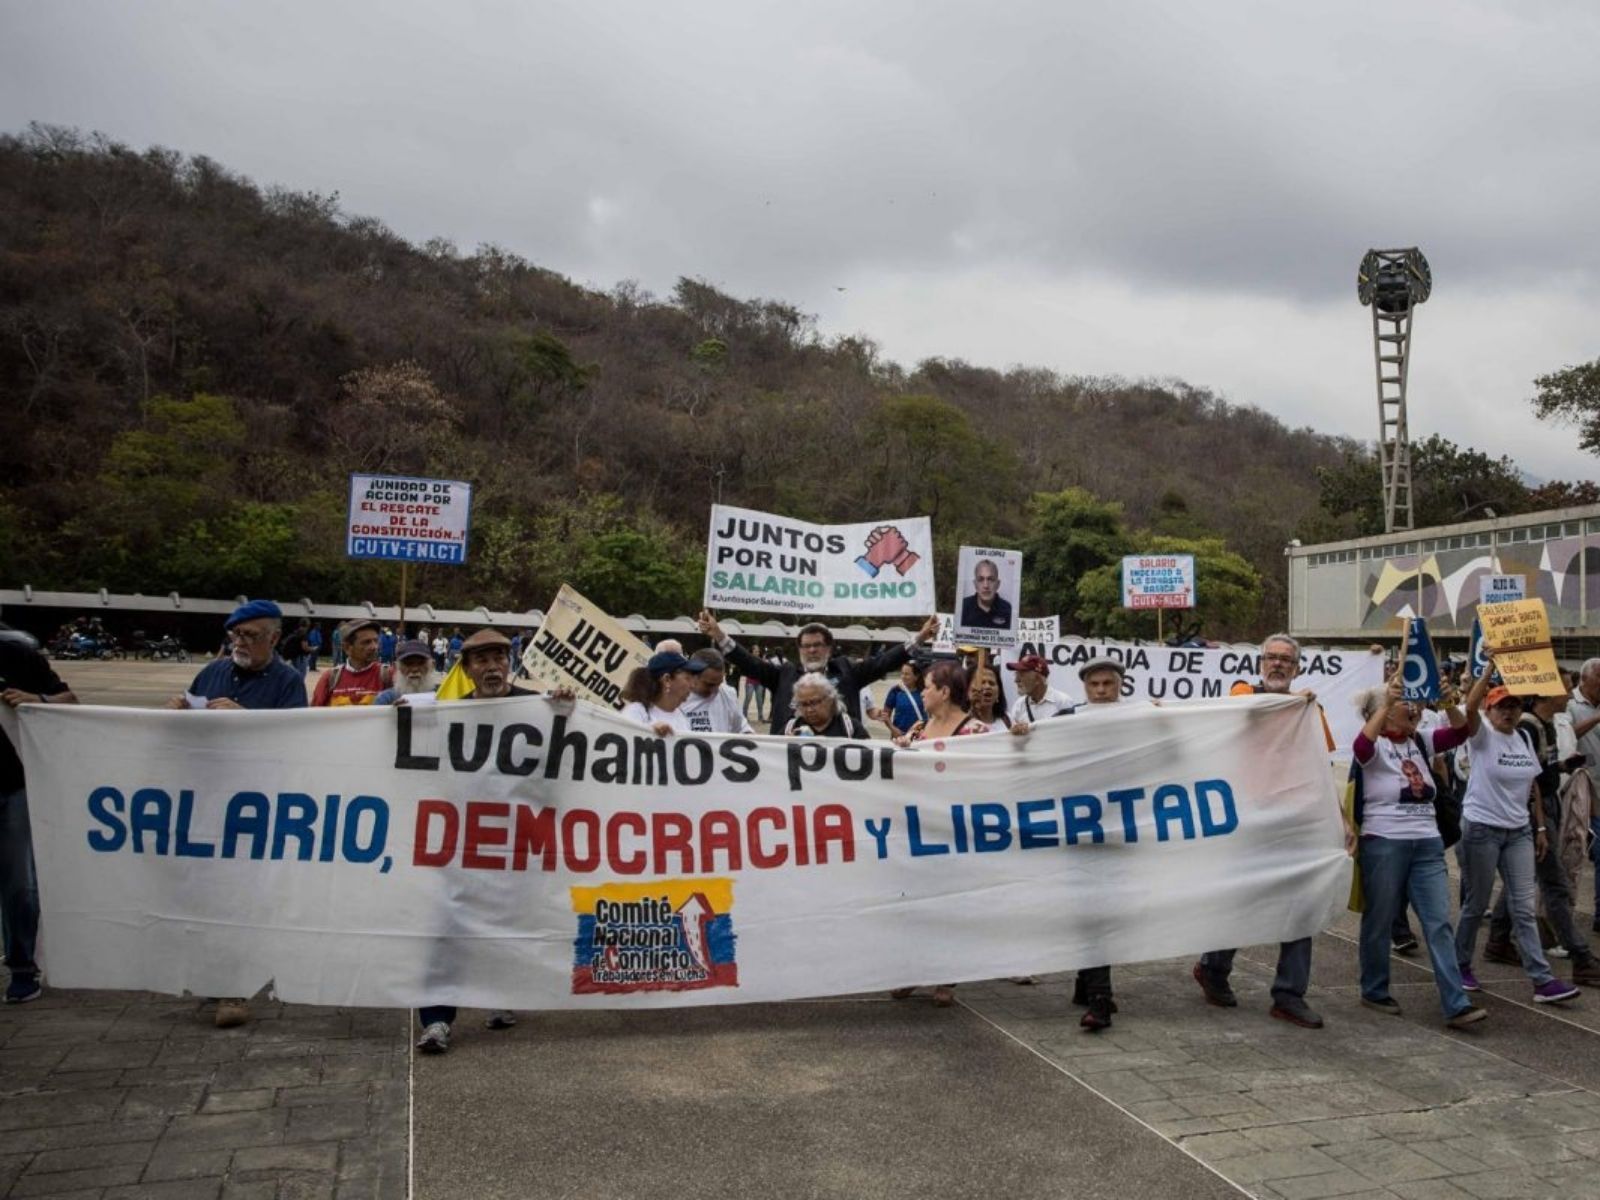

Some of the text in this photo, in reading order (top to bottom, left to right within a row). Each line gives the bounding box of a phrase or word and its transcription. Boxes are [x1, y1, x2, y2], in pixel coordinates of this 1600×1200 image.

[423, 494, 451, 505] POR
[433, 484, 451, 494] DE
[361, 502, 441, 515] EL RESCATE
[390, 515, 429, 527] DE LA
[717, 518, 846, 554] JUNTOS
[717, 546, 817, 577] POR UN
[712, 570, 917, 599] SALARIO DIGNO
[566, 618, 629, 674] UCV
[1169, 651, 1204, 674] DE
[394, 705, 760, 787] Luchamos
[87, 786, 393, 874] SALARIO,
[412, 799, 856, 874] DEMOCRACIA
[905, 778, 1239, 857] LIBERTAD
[596, 896, 672, 924] Comité
[594, 925, 679, 947] Nacional
[605, 946, 690, 971] Conflicto
